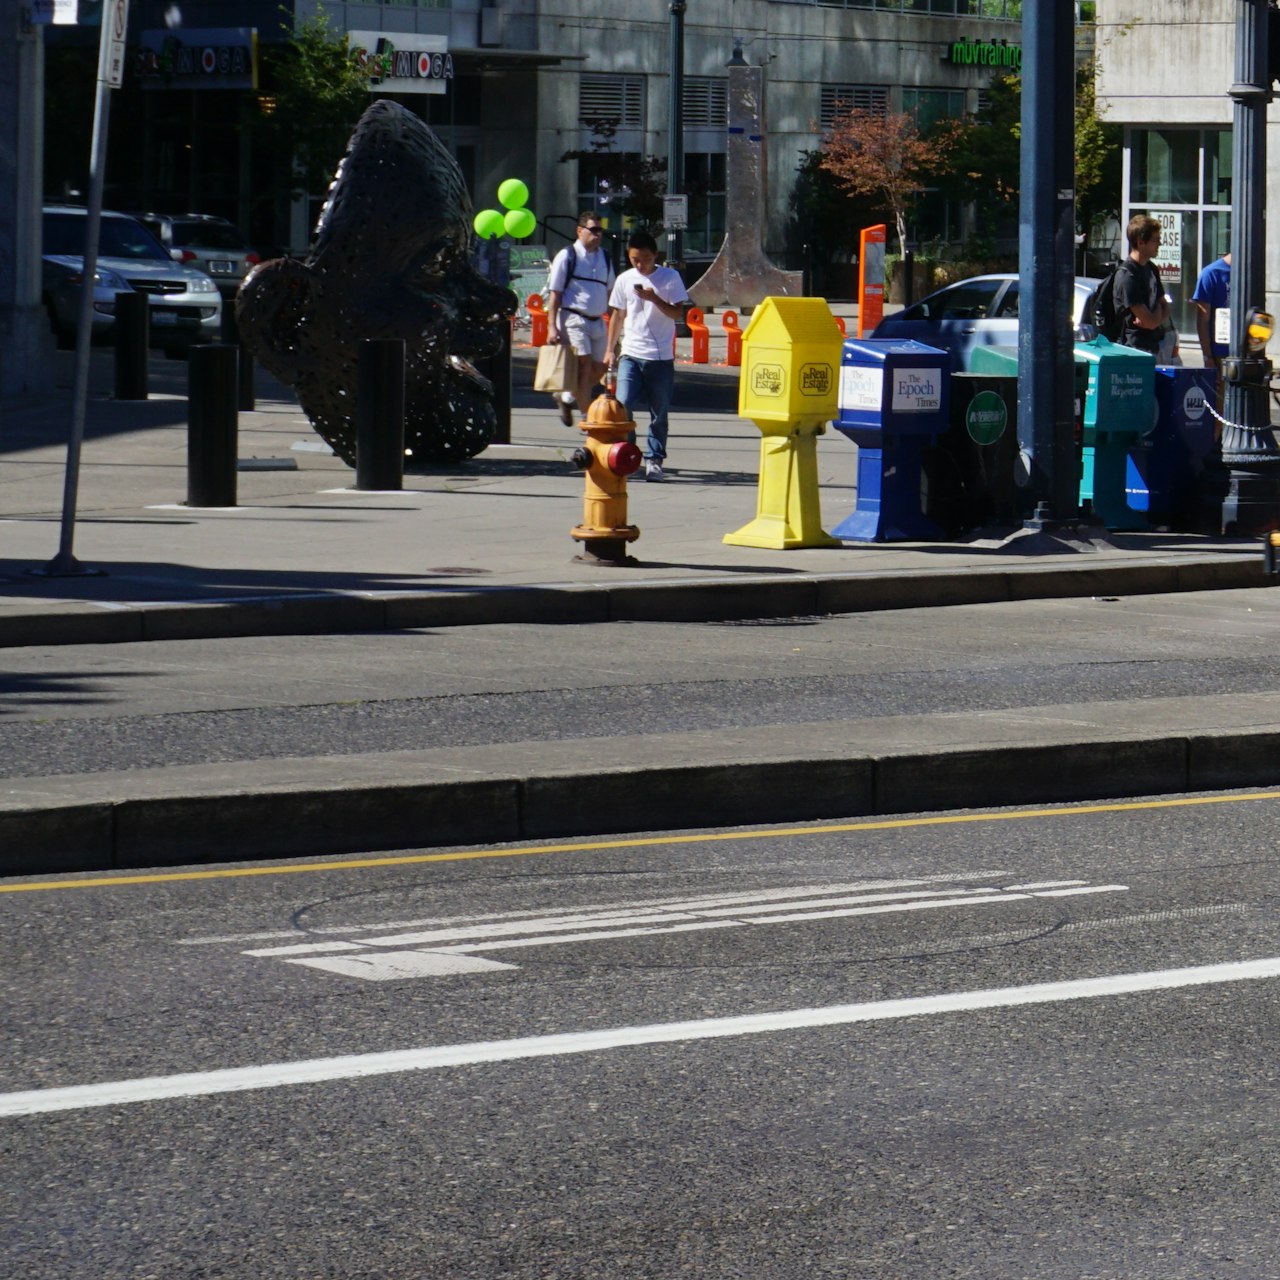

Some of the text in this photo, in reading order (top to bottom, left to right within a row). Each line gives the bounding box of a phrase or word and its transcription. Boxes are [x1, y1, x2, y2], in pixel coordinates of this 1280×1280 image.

[1157, 214, 1175, 230] FOR
[763, 368, 780, 380] Real
[809, 367, 828, 379] Real
[755, 377, 781, 388] Estate
[803, 378, 829, 389] Estate
[908, 375, 921, 383] The
[1111, 374, 1143, 384] The Asian
[898, 380, 934, 398] Epoch
[1111, 385, 1143, 398] Reporter
[915, 397, 938, 407] Times
